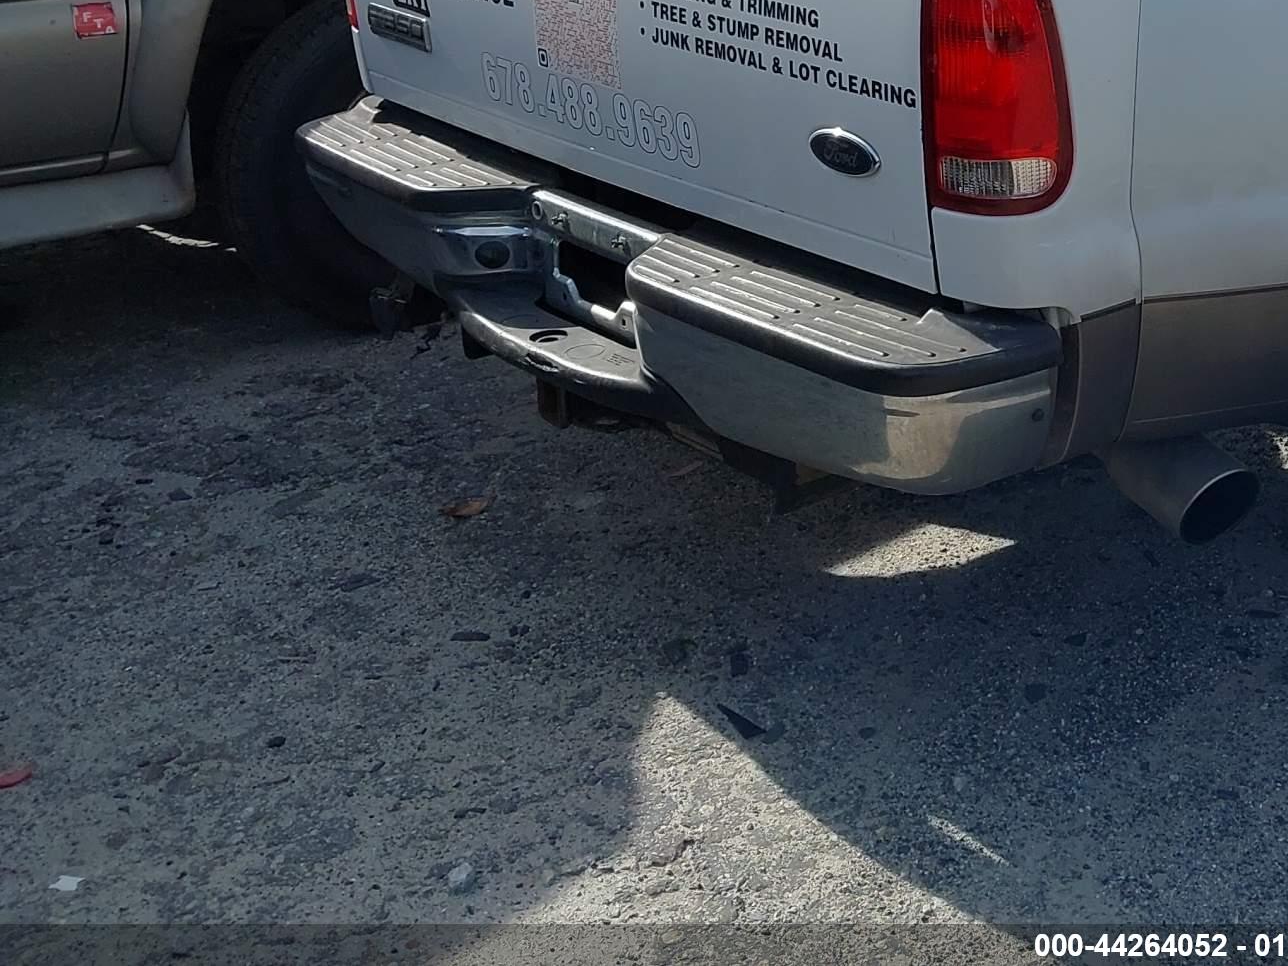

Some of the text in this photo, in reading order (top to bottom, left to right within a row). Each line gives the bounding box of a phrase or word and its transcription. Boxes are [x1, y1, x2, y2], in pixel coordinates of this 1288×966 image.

[651, 0, 843, 63] TREE & STUMP REMOVAL
[651, 27, 917, 109] JUNK REMOVAL & LOT CLEARING
[480, 51, 701, 169] 678.488.9639
